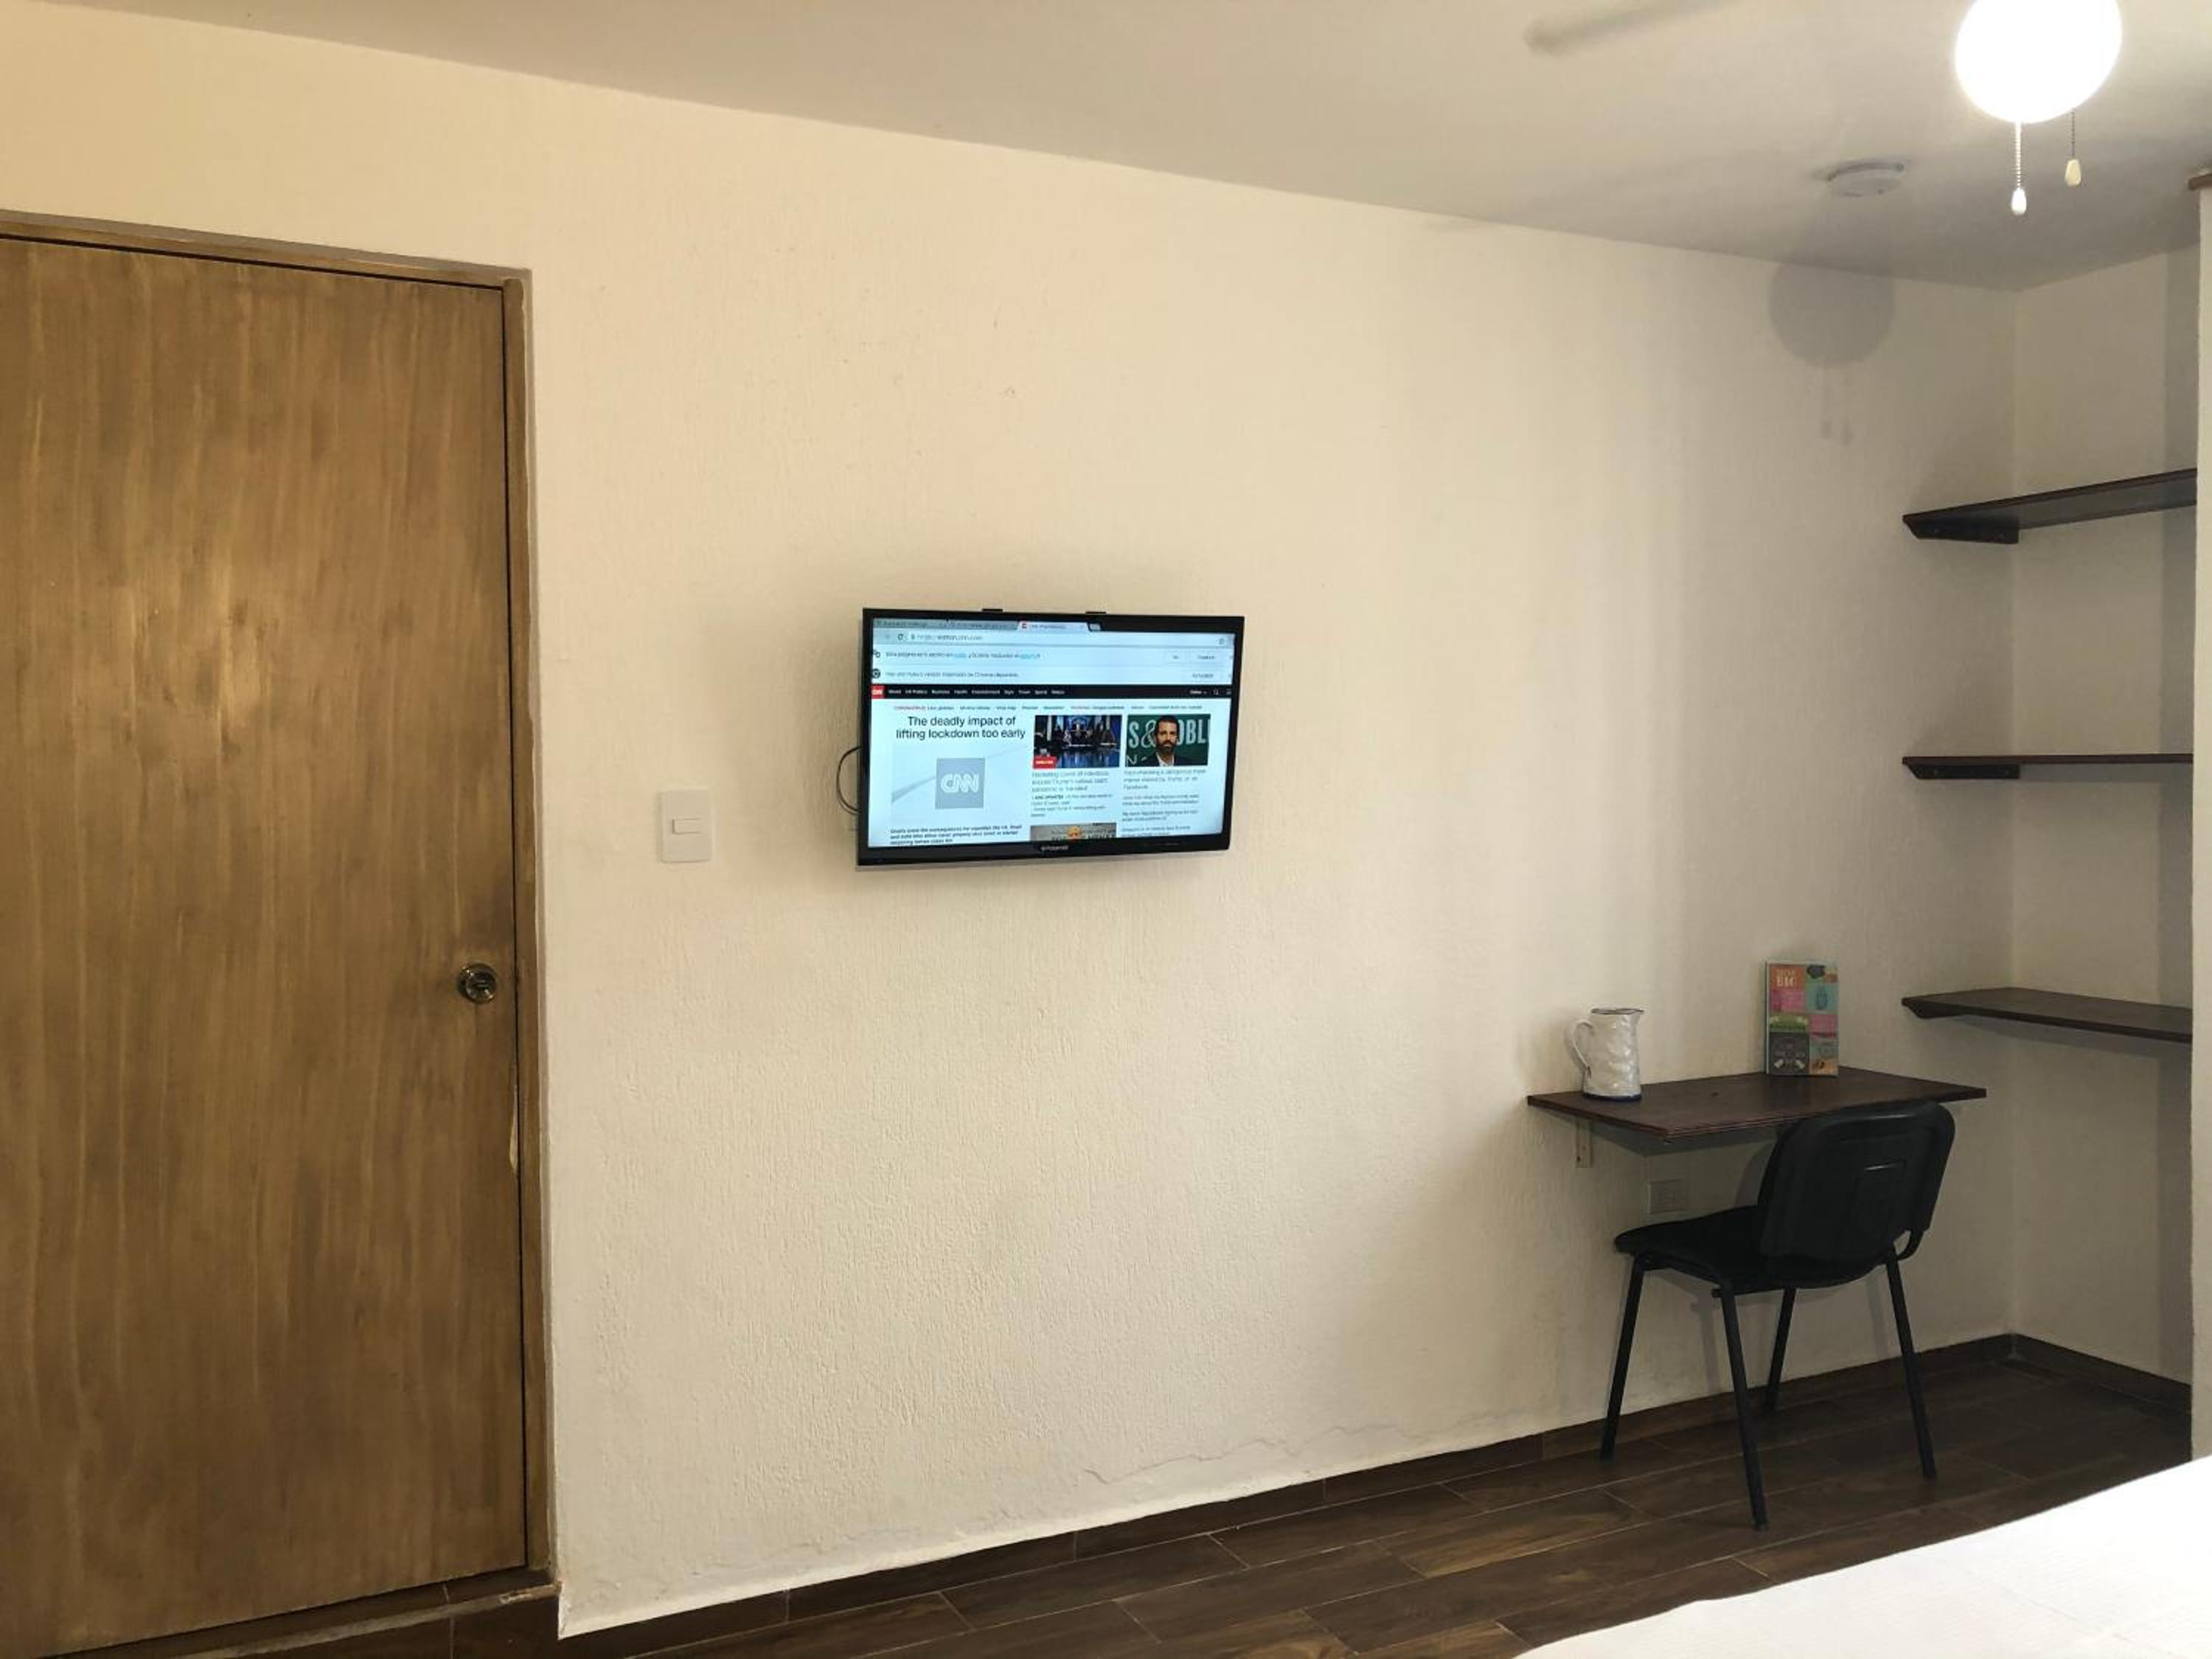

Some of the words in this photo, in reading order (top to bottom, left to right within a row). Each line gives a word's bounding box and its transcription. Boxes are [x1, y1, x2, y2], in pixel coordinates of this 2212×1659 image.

[908, 716, 928, 726] The
[930, 716, 965, 728] deadly
[967, 716, 1004, 728] impact
[1005, 715, 1017, 726] of
[896, 729, 925, 740] lifting
[928, 728, 980, 738] lockdown
[981, 728, 999, 738] too
[1001, 728, 1026, 740] early
[940, 773, 980, 793] CNN
